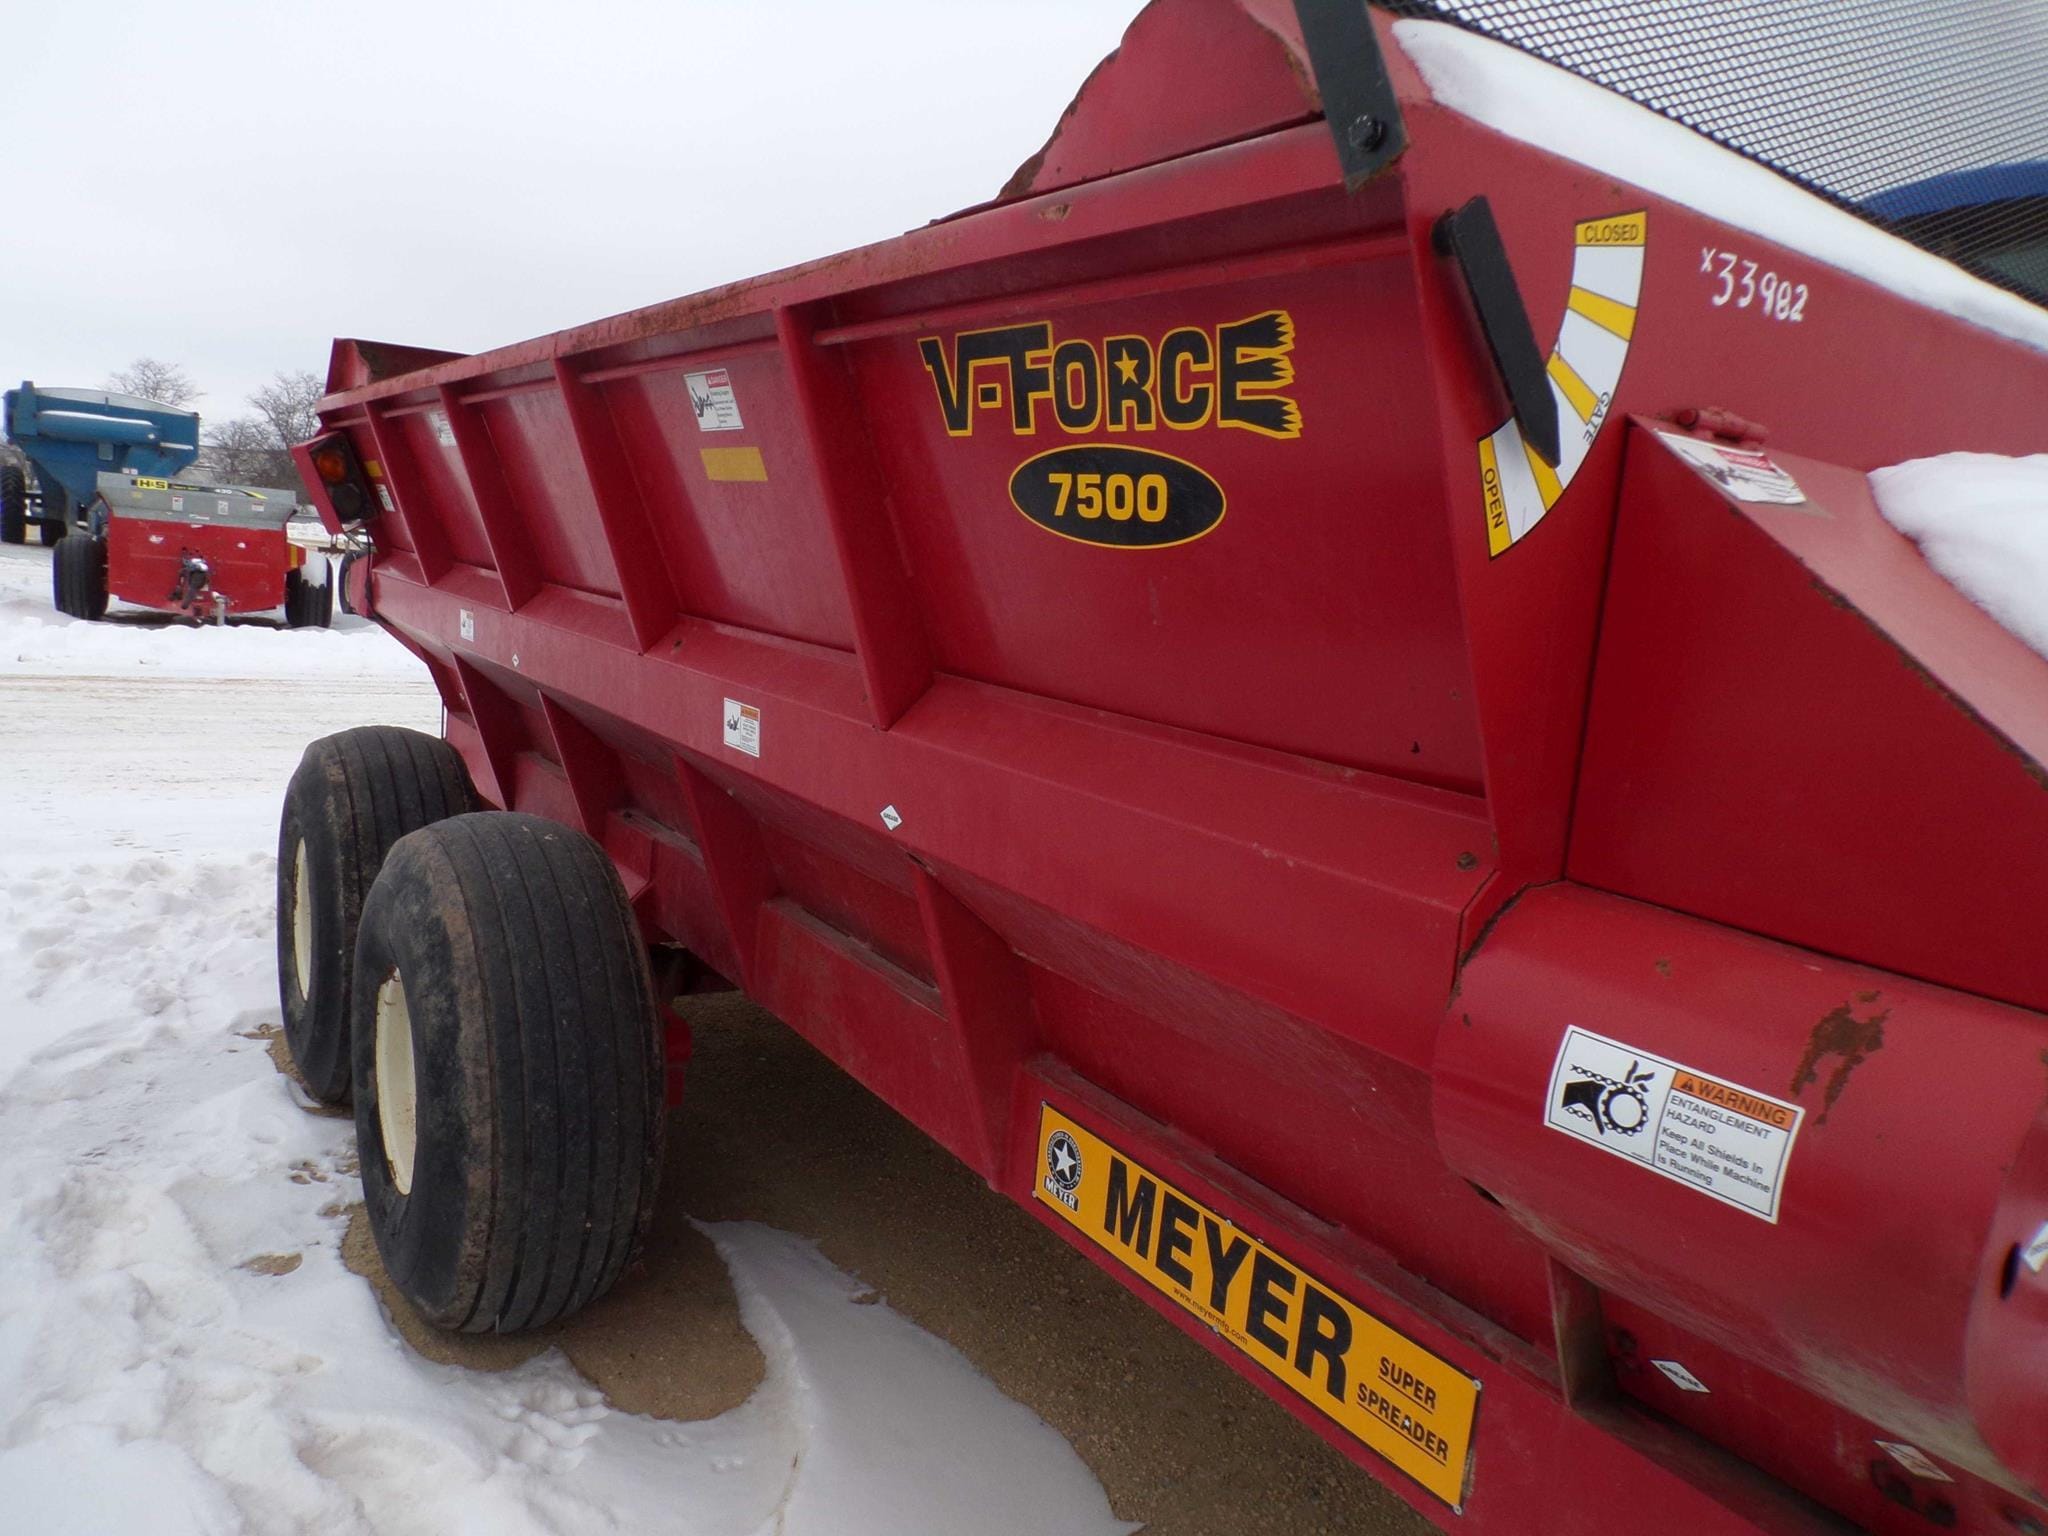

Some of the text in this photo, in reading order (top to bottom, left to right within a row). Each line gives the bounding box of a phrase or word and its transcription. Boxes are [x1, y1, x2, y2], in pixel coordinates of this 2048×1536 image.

[1584, 224, 1639, 243] CLOSED
[917, 310, 1303, 440] V-FORCE
[1583, 391, 1611, 445] GATE
[1048, 473, 1168, 522] 7500
[1484, 468, 1504, 529] OPEN
[1666, 1109, 1716, 1135] HAZARD
[1670, 1095, 1772, 1139] ENTANGLEMENT
[1700, 1082, 1787, 1125] WARNING
[1657, 1153, 1667, 1165] Is
[1669, 1158, 1713, 1186] Running
[1660, 1140, 1687, 1158] Place
[1691, 1153, 1720, 1172] While
[1723, 1166, 1771, 1193] Machine
[1662, 1126, 1764, 1175] Keep All Shields In
[1045, 1176, 1076, 1210] MEYER
[1104, 1154, 1353, 1404] MEYER
[1173, 1286, 1249, 1345] www.meyermfg.com
[1379, 1356, 1436, 1410] SUPER
[1357, 1382, 1449, 1461] SPREADER
